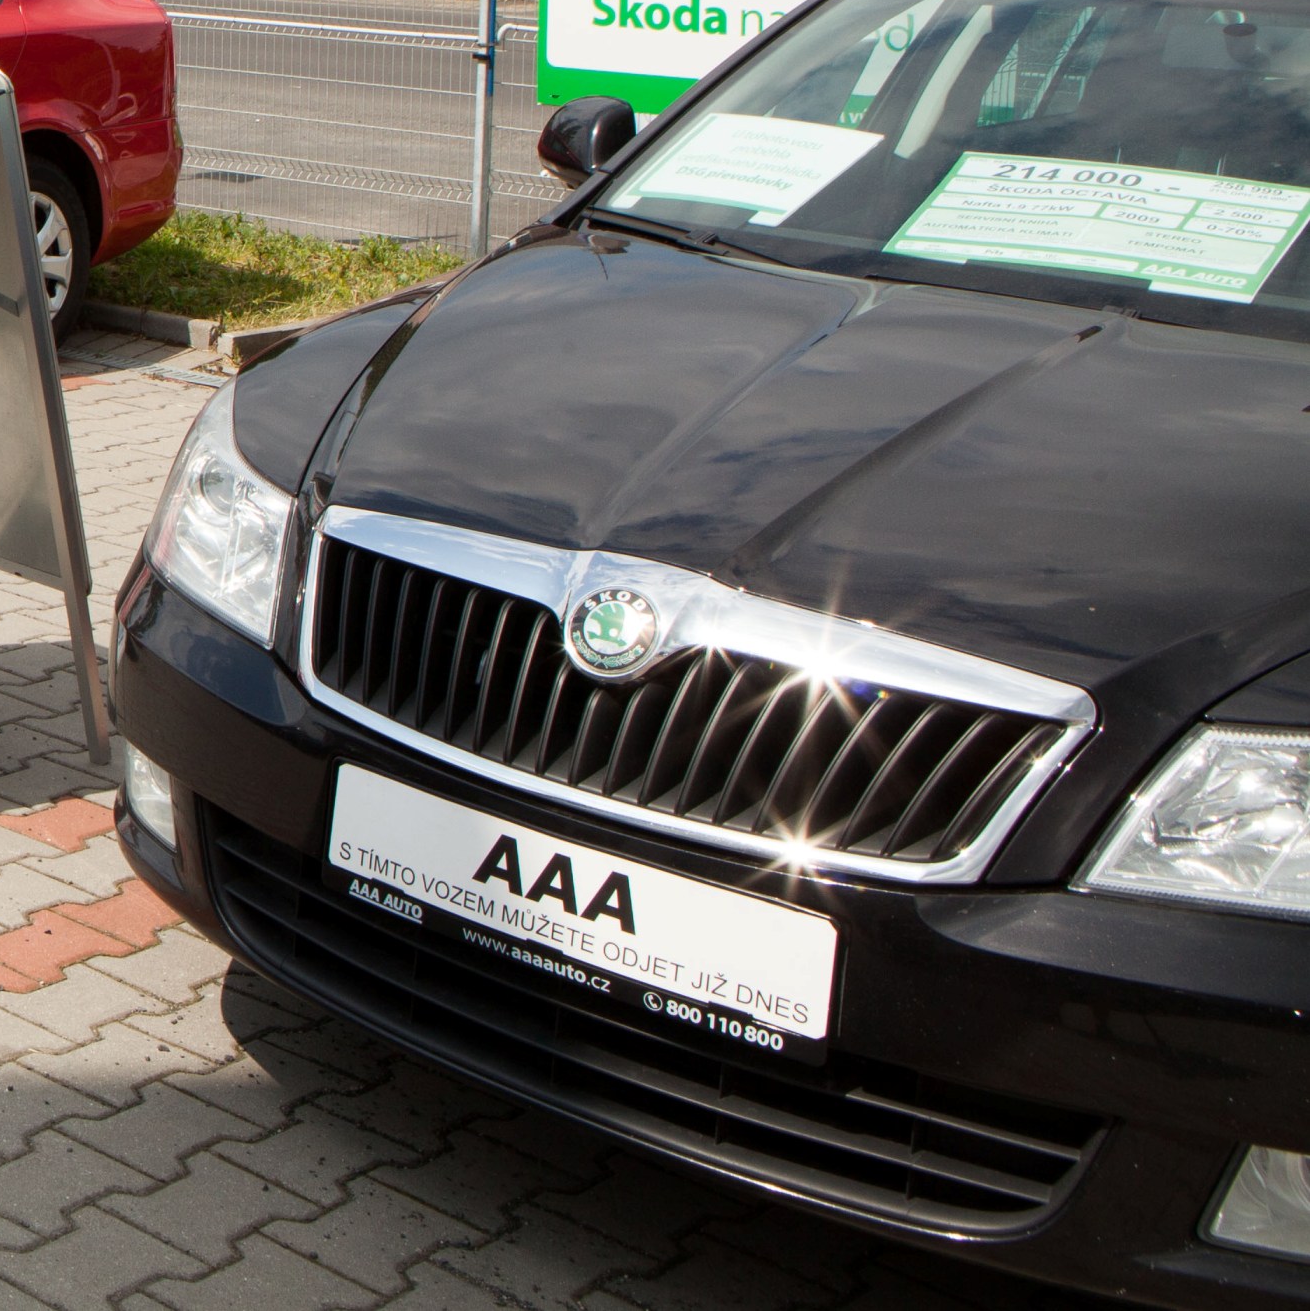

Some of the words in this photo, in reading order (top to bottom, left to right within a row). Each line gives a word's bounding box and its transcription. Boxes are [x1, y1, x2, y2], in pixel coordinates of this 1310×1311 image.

[675, 166, 707, 176] DSG
[992, 164, 1061, 181] 214
[1073, 170, 1142, 187] 000
[1212, 180, 1244, 191] 258
[987, 183, 1053, 196] ŠKODA
[1060, 188, 1147, 205] OCTAVIA
[962, 200, 1002, 209] Nafta
[1005, 202, 1027, 210] 1.9
[1031, 202, 1075, 212] 77kW
[956, 213, 1017, 224] SERVISNÍ
[1019, 217, 1059, 226] KNIHA
[1114, 210, 1160, 224] 2009
[1214, 208, 1225, 216] 2
[1230, 211, 1263, 221] 500
[1144, 231, 1202, 244] STEREO
[1206, 224, 1263, 239] 0-70%
[1128, 240, 1206, 255] TEMPOMAT
[1141, 264, 1186, 278] AAA
[1190, 272, 1248, 287] AUTO
[472, 833, 637, 936] AAA
[349, 879, 380, 904] AAA
[383, 891, 423, 921] AUTO
[339, 842, 354, 864] S
[356, 845, 417, 889] TÍMTO
[419, 875, 496, 923] VOZEM
[500, 904, 596, 956] MŮŽETE
[602, 940, 686, 984] ODJET
[690, 970, 729, 1000] JIŽ
[735, 982, 810, 1025] DNES
[461, 926, 612, 995] www.aaaauto.cz
[665, 997, 702, 1025] 800
[706, 1011, 742, 1039] 110
[743, 1022, 785, 1052] 800
